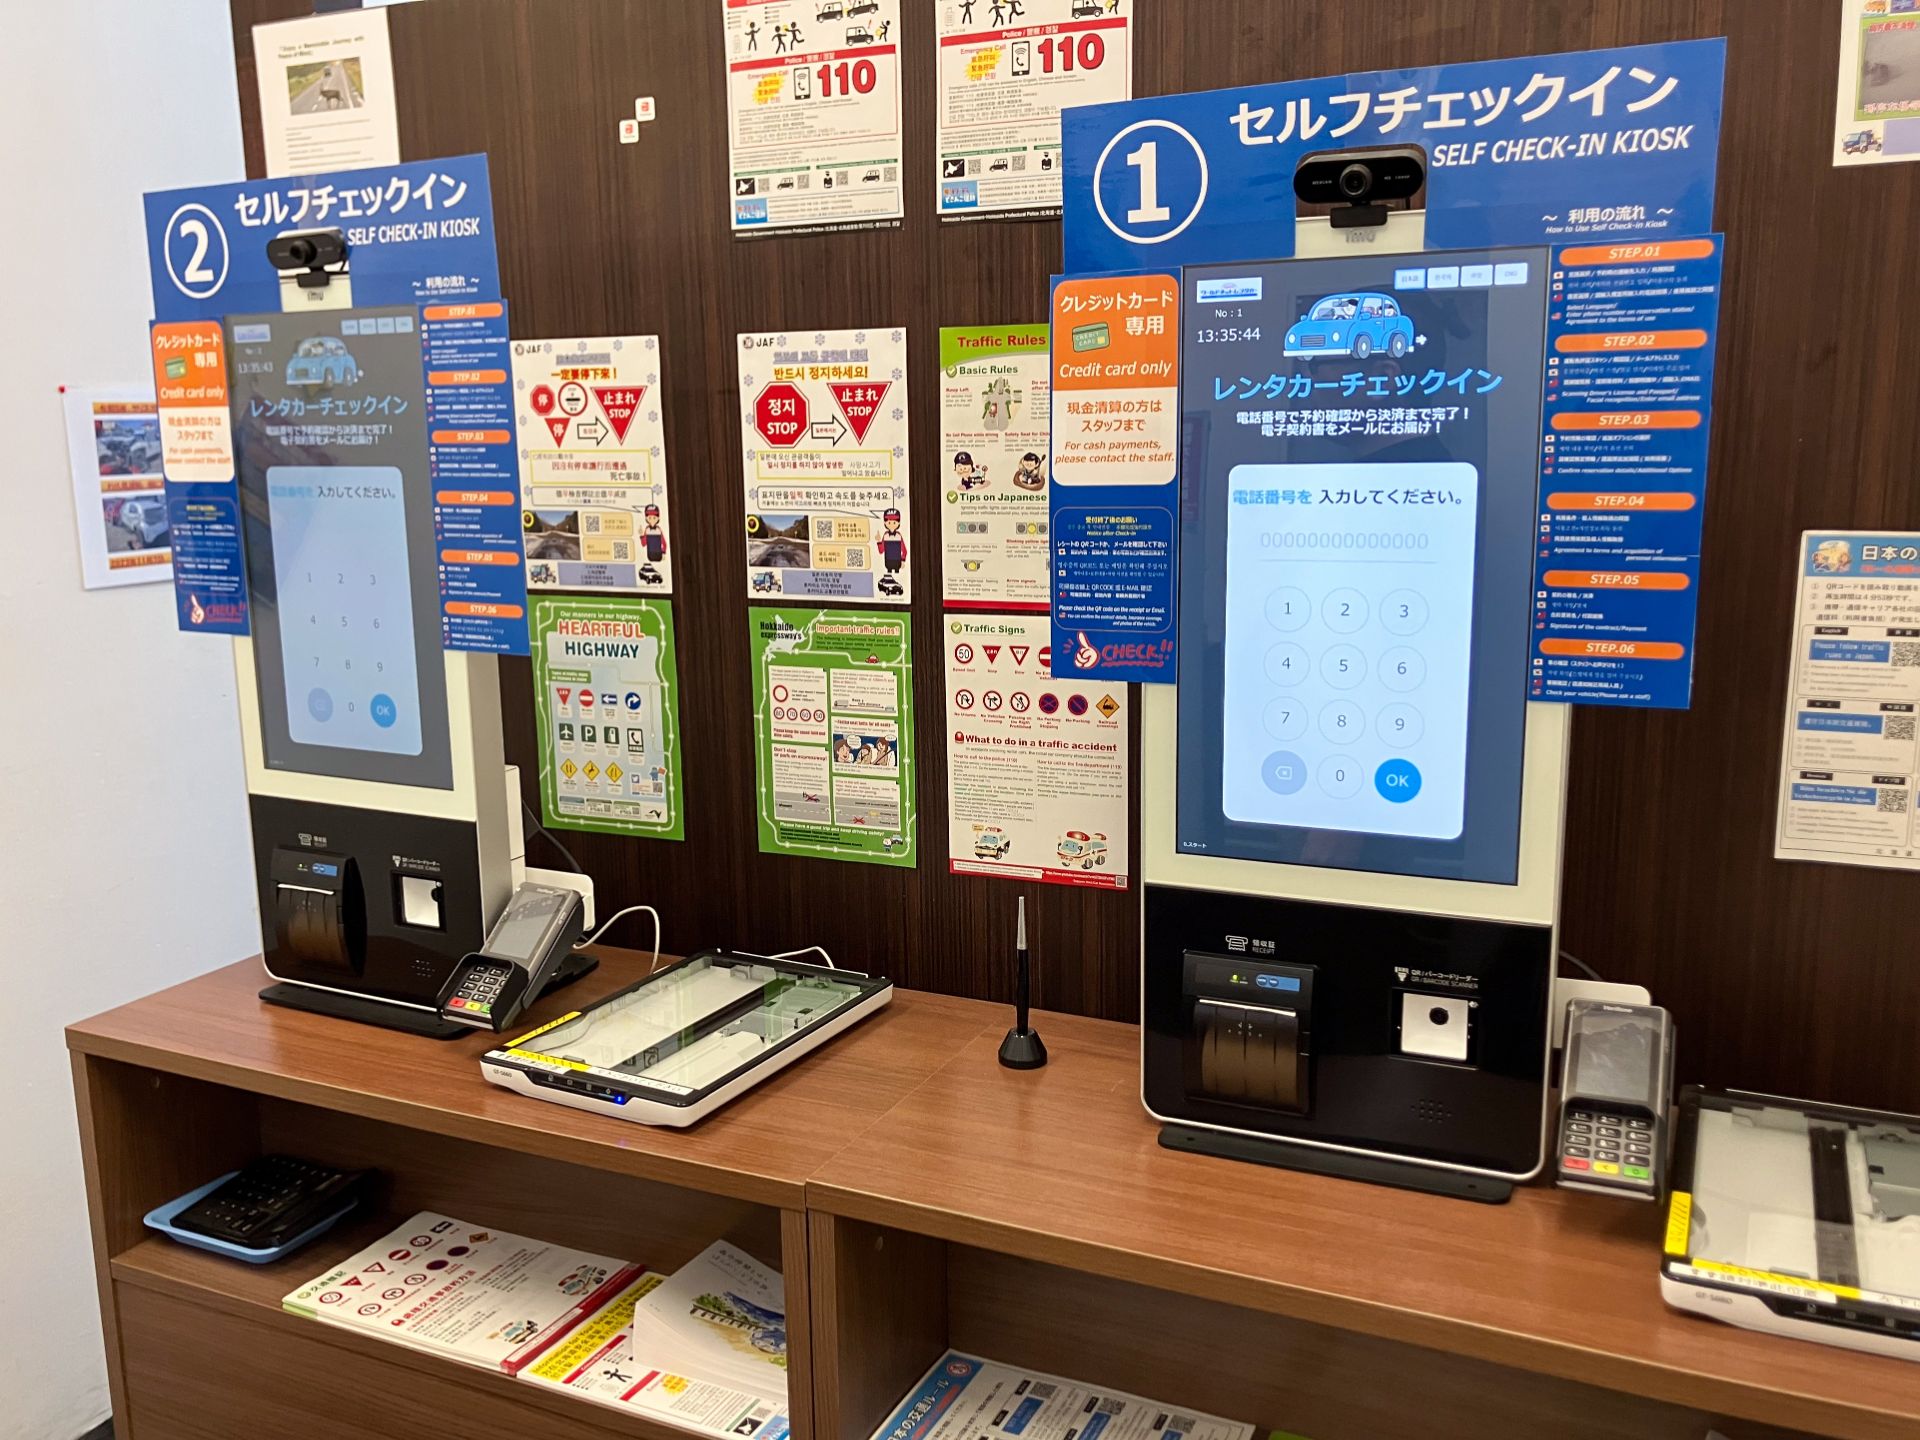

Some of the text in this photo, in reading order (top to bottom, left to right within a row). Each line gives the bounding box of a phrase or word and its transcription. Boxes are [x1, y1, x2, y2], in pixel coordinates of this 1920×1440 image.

[960, 46, 993, 56] Emergency
[1038, 33, 1105, 73] 110
[816, 60, 876, 97] 110
[1230, 65, 1678, 147] セルフチェックイン
[1432, 126, 1692, 168] SELF CHECK-IN KIOSK
[234, 172, 468, 228] セルフチェックイン
[1568, 205, 1645, 224] 利用の流れ
[1609, 222, 1643, 230] Check-in
[1646, 220, 1668, 228] Kiosk
[348, 217, 481, 247] SELF CHECK-IN KIOSK
[1609, 246, 1660, 259] STEP.01
[1060, 290, 1174, 314] クレジットカード
[449, 308, 476, 316] STEP.01
[1215, 308, 1242, 318] No 1
[1126, 315, 1164, 336] 専用
[156, 332, 221, 349] クレジットカード
[958, 335, 1046, 348] Traffic Rules
[1197, 328, 1261, 343] 13:35:44
[1604, 335, 1655, 347] STEP.02
[757, 338, 775, 347] JAF
[526, 345, 542, 354] JAF
[194, 352, 218, 368] 専用
[238, 362, 273, 374] 13:35:43
[774, 366, 868, 381] 반드시 정지하세요!
[960, 365, 1018, 375] Basic Rules
[1060, 360, 1172, 378] Credit card only
[1214, 368, 1503, 401] レンタカーチェックイン
[160, 386, 225, 400] Credit card only
[603, 392, 637, 406] 止まれ
[841, 389, 879, 403] 止まれ
[251, 395, 408, 418] レンタカーチェックイン
[538, 394, 548, 406] 停
[609, 408, 631, 419] STOP
[768, 399, 796, 416] 정지
[848, 407, 872, 417] STOP
[1067, 400, 1163, 414] 現金清算の方は
[1237, 407, 1470, 425] 電話番号で予約確認から決済まで完了！
[1599, 415, 1650, 425] STEP.03
[553, 423, 565, 437] 停
[767, 422, 798, 435] STOP
[1082, 419, 1145, 433] スタッフまで
[1261, 421, 1442, 437] 電子契約書をメールにお届け！
[1065, 440, 1161, 452] For cash payments,
[1055, 452, 1174, 464] please contact the staff.
[317, 486, 397, 499] 入力してください。
[462, 494, 488, 502] STEP.04
[960, 493, 981, 503] Tips
[998, 493, 1047, 503] Japanese
[1233, 489, 1462, 505] 電話番号を 入力してください。
[1594, 496, 1645, 506] STEP.04
[466, 553, 493, 561] STEP.05
[307, 573, 312, 583] 1
[338, 574, 344, 585] 2
[370, 574, 376, 585] 3
[1590, 574, 1640, 585] STEP.05
[470, 605, 497, 614] STEP.06
[1283, 602, 1293, 615] 1
[1340, 603, 1351, 617] 2
[1399, 605, 1409, 619] 3
[311, 615, 316, 626] 4
[342, 616, 348, 627] 5
[374, 618, 380, 629] 6
[760, 621, 794, 631] Hokkaido
[558, 619, 646, 639] HEARTFUL
[964, 624, 1026, 635] Traffic Signs
[565, 641, 639, 659] HIGHWAY
[958, 649, 970, 659] 50
[1586, 643, 1635, 654] STEP.06
[314, 657, 320, 669] 7
[377, 662, 383, 673] 9
[1281, 657, 1292, 670] 4
[1339, 659, 1349, 673] 5
[1397, 661, 1407, 676] 6
[349, 702, 354, 713] 0
[376, 705, 390, 717] OK
[1281, 711, 1291, 724] 7
[1337, 714, 1347, 729] 8
[1395, 717, 1405, 731] 9
[586, 727, 593, 741] P
[966, 735, 1117, 752] What to do in a traffic accident
[1336, 769, 1345, 783] 0
[1386, 773, 1409, 788] OK
